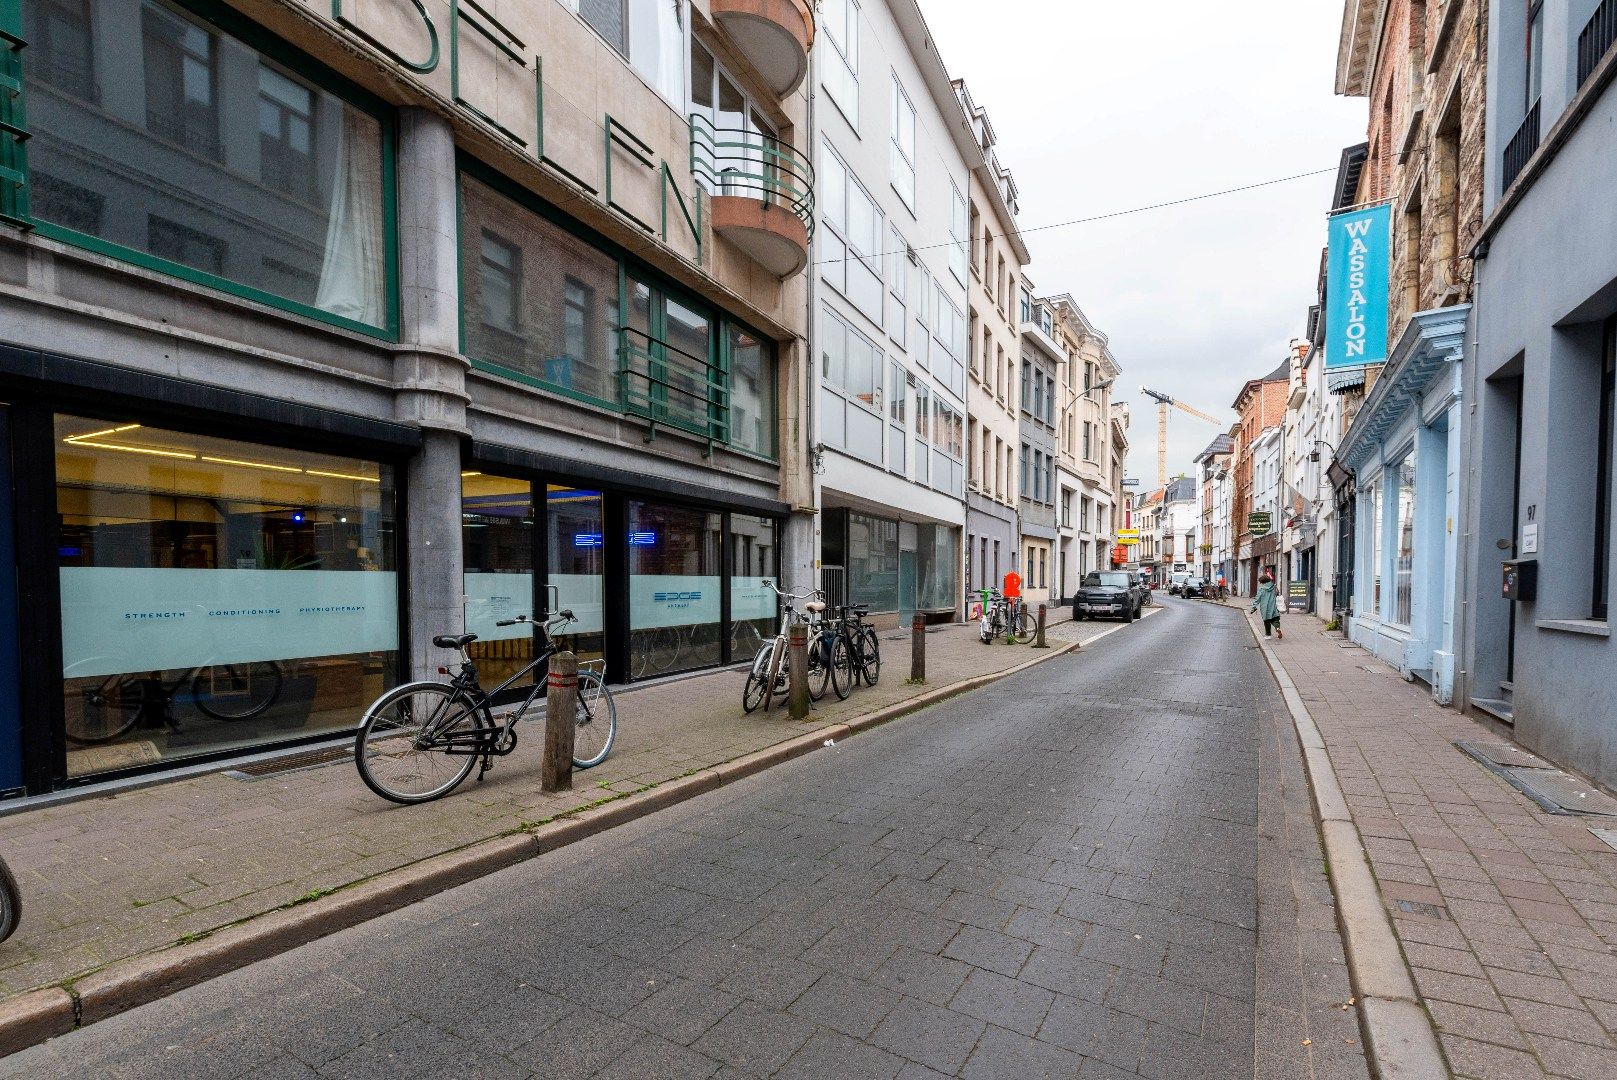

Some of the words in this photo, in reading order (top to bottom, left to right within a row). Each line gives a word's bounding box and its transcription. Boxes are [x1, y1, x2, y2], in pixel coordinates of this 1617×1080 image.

[1344, 218, 1372, 357] WASSALON
[1527, 505, 1537, 521] 97
[124, 612, 186, 620] STRENGTH
[208, 608, 281, 616] CONDITIONING
